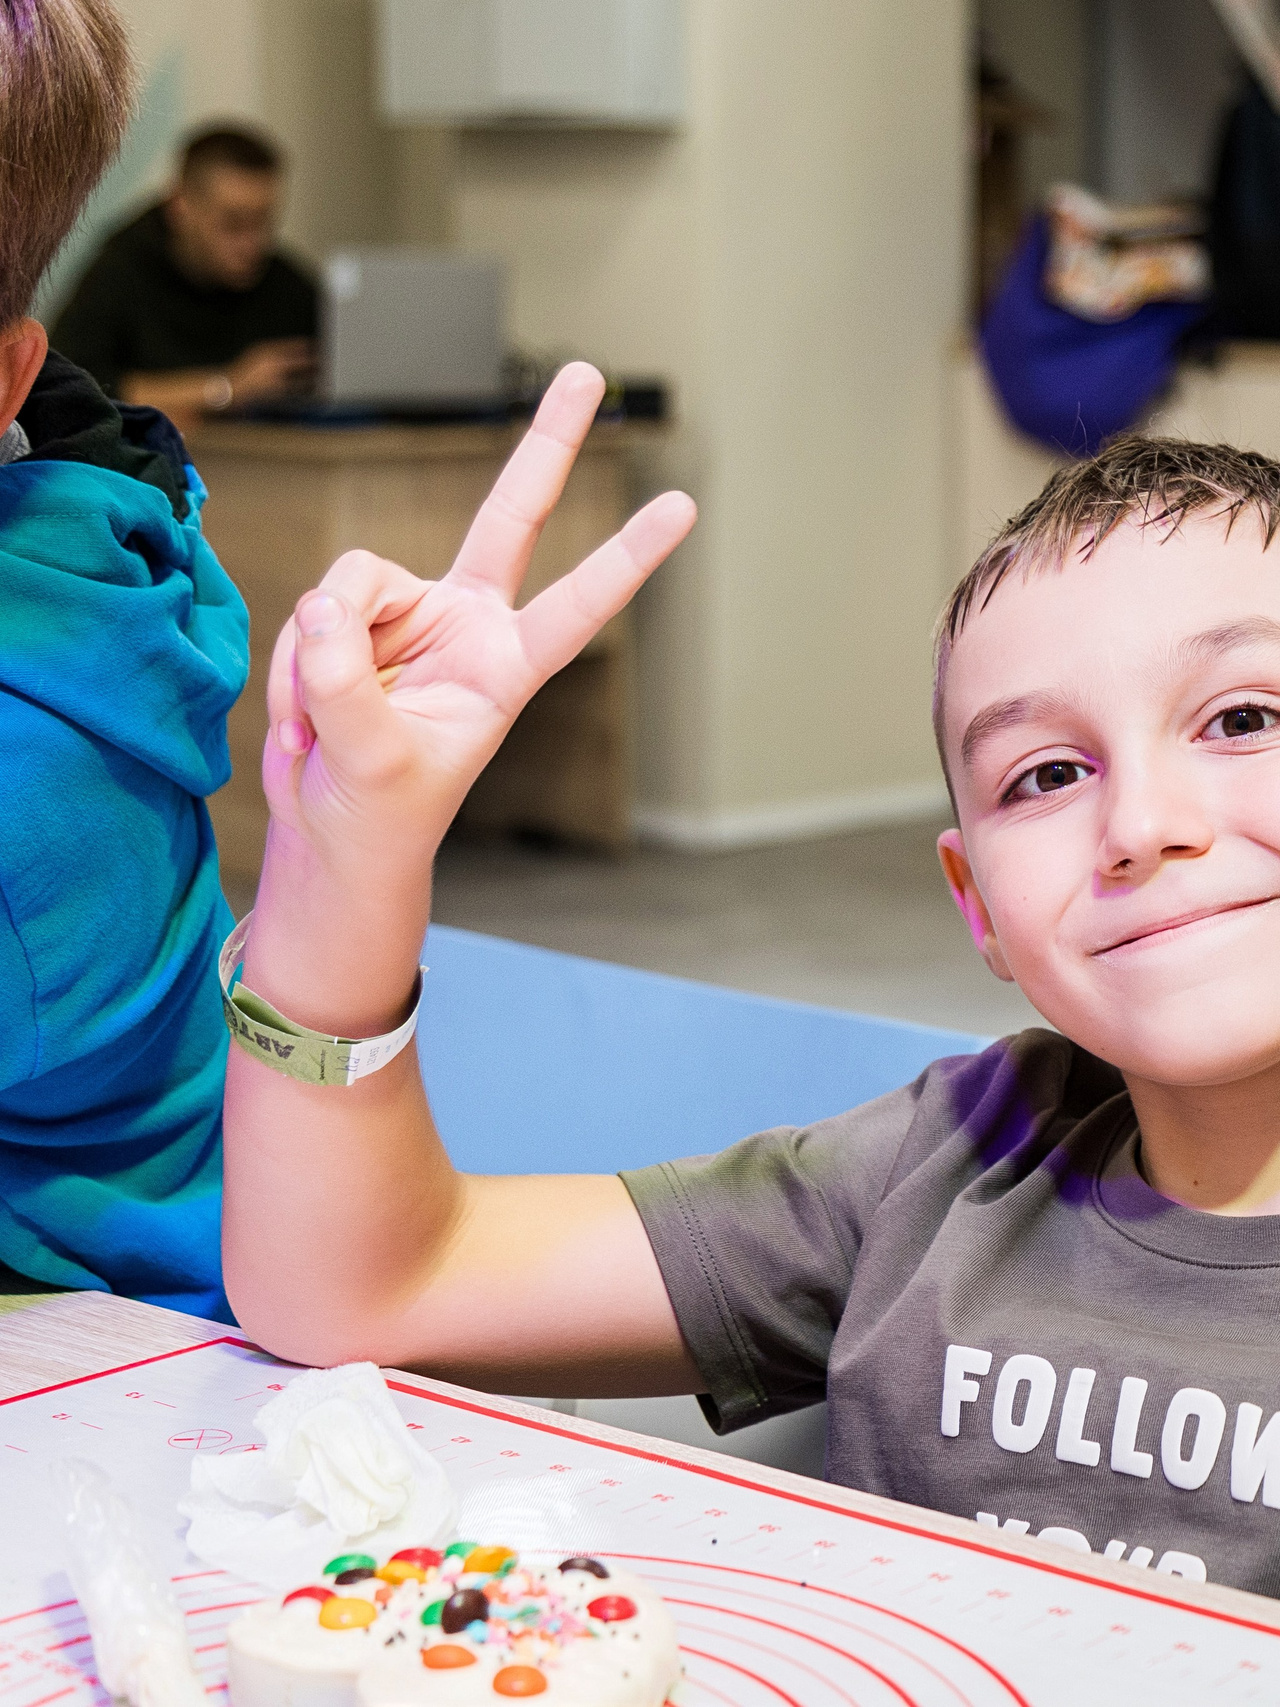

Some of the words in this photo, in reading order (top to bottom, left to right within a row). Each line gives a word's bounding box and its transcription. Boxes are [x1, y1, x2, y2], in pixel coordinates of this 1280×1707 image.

[124, 1391, 144, 1400] 13
[51, 1412, 72, 1421] 12
[450, 1435, 472, 1444] 42
[499, 1450, 520, 1458] 40
[549, 1464, 572, 1473] 38
[651, 1493, 674, 1503] 34
